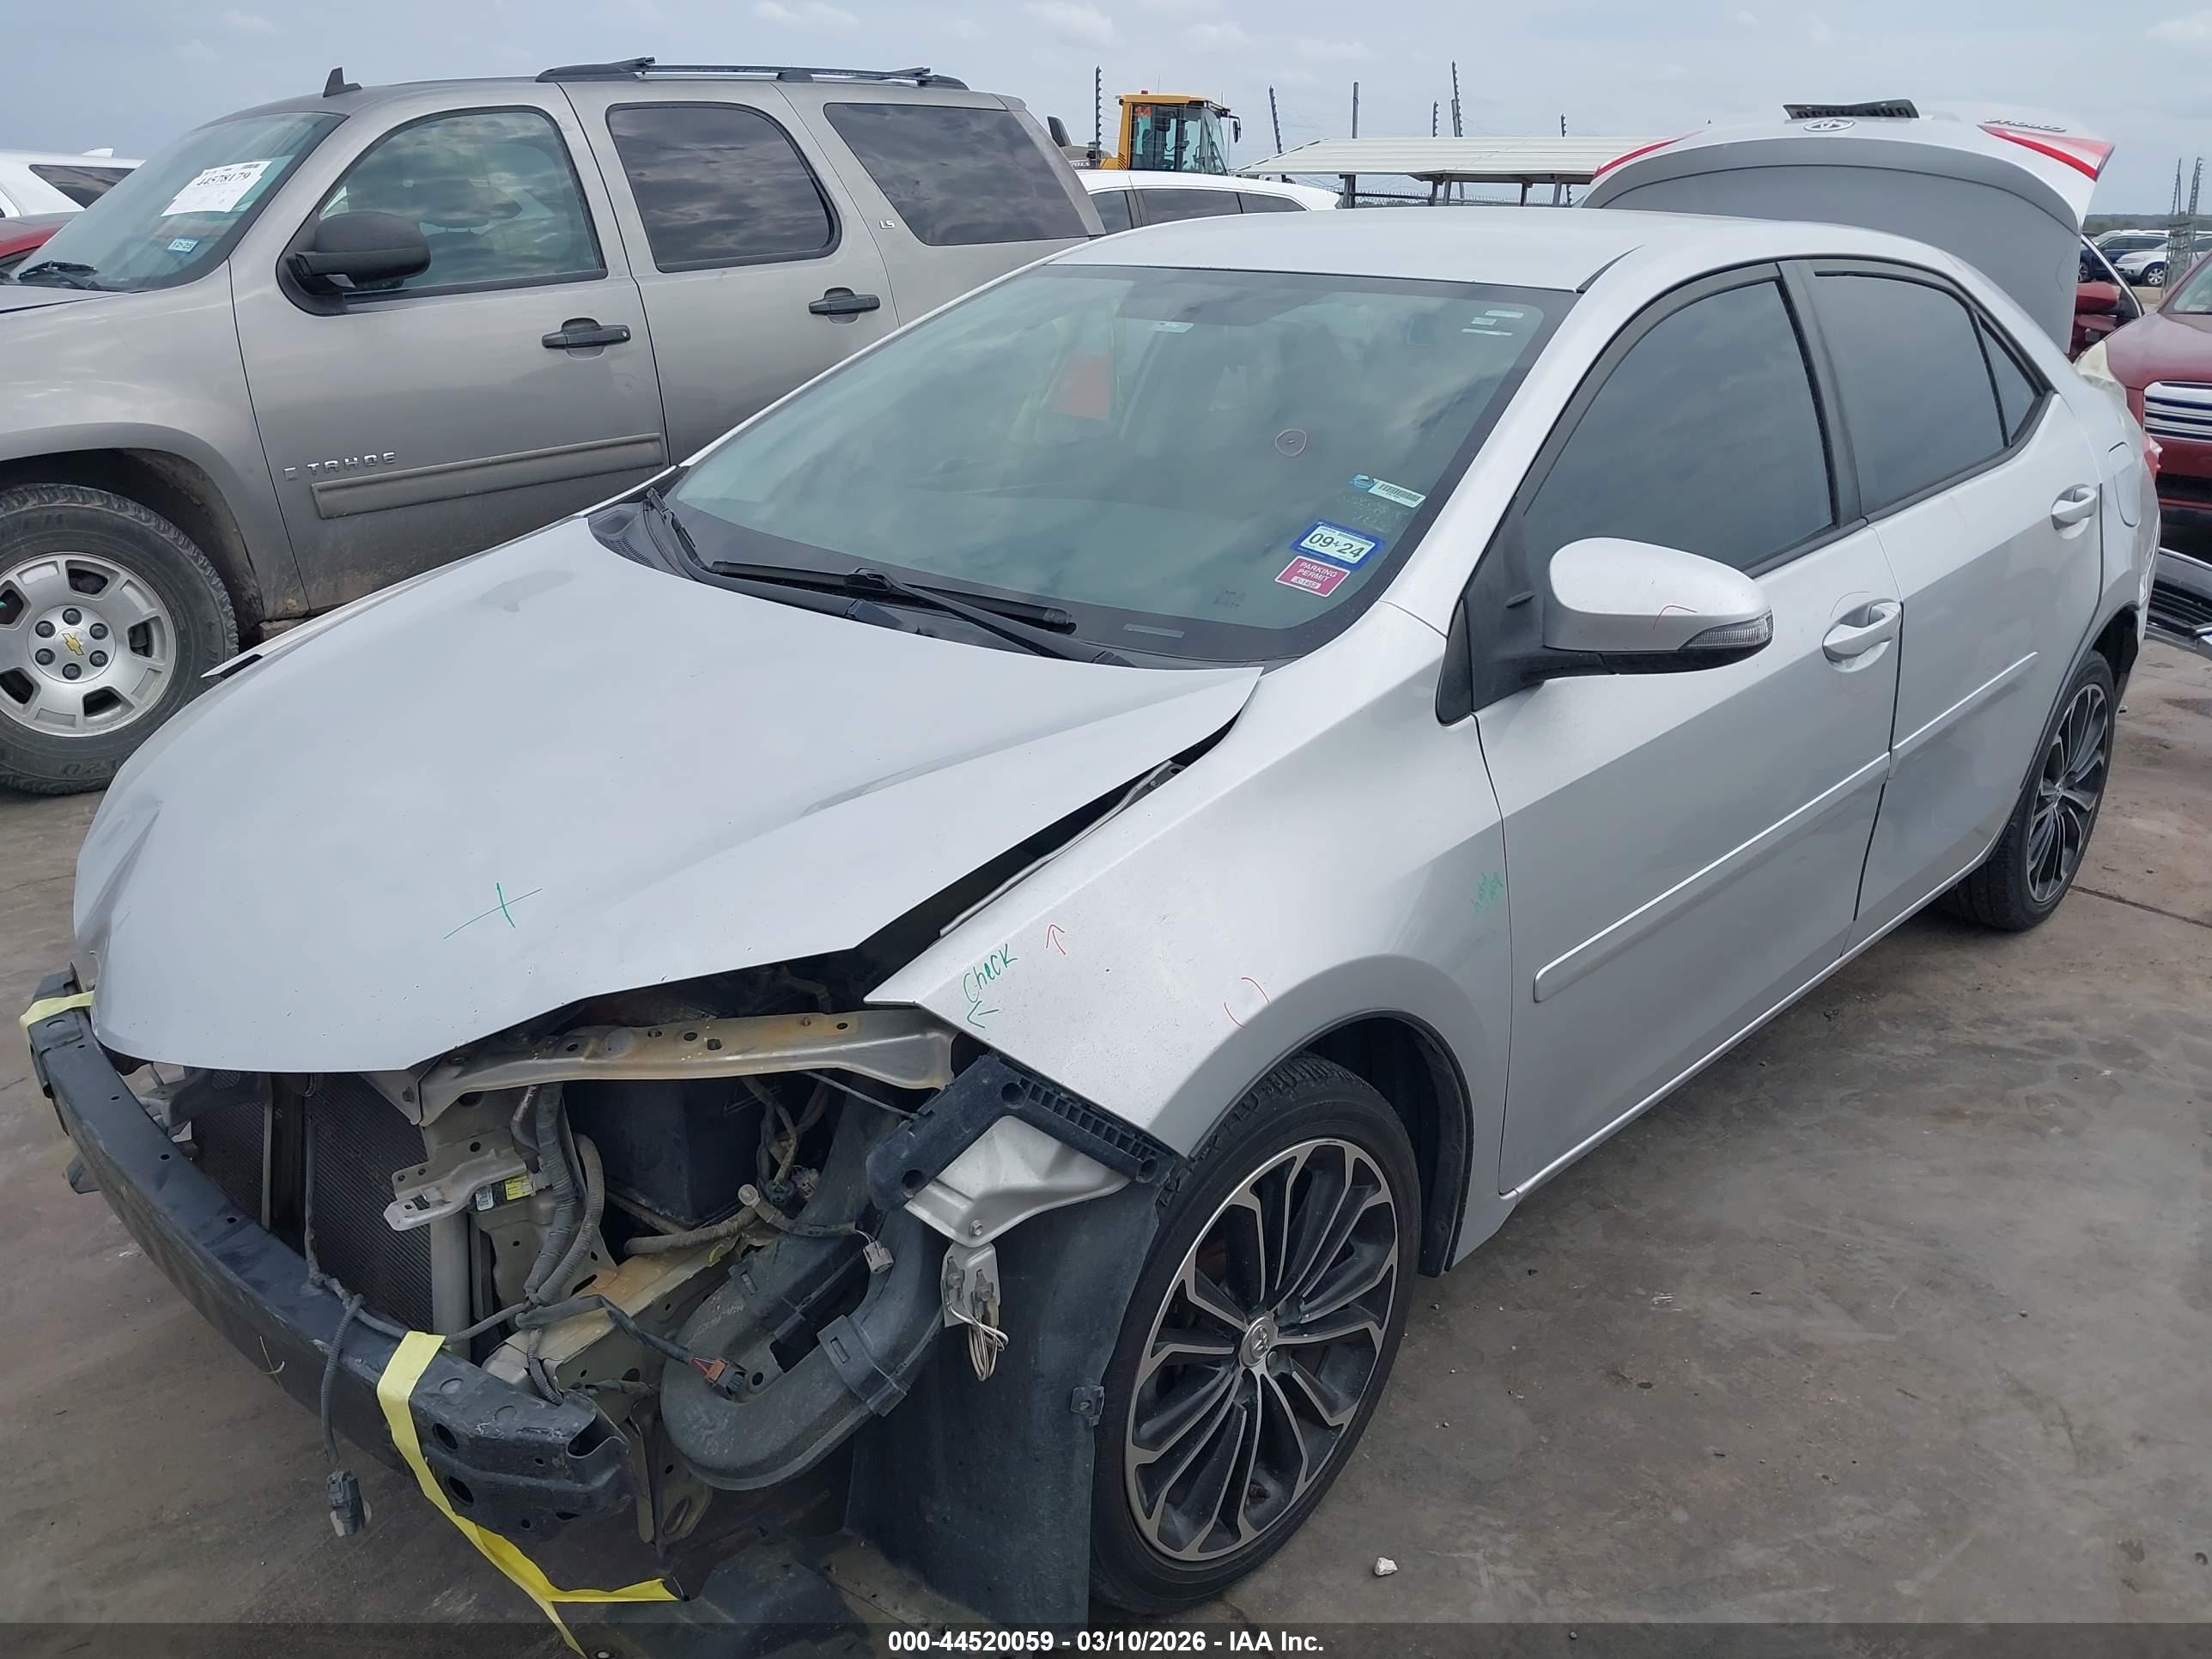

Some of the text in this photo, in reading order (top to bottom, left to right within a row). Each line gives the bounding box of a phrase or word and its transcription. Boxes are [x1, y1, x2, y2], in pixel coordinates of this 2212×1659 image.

[196, 171, 252, 186] 44578179
[879, 220, 895, 229] LS
[307, 451, 395, 476] TAHOE
[1297, 568, 1331, 582] PERMIT
[1299, 562, 1338, 578] PARKING
